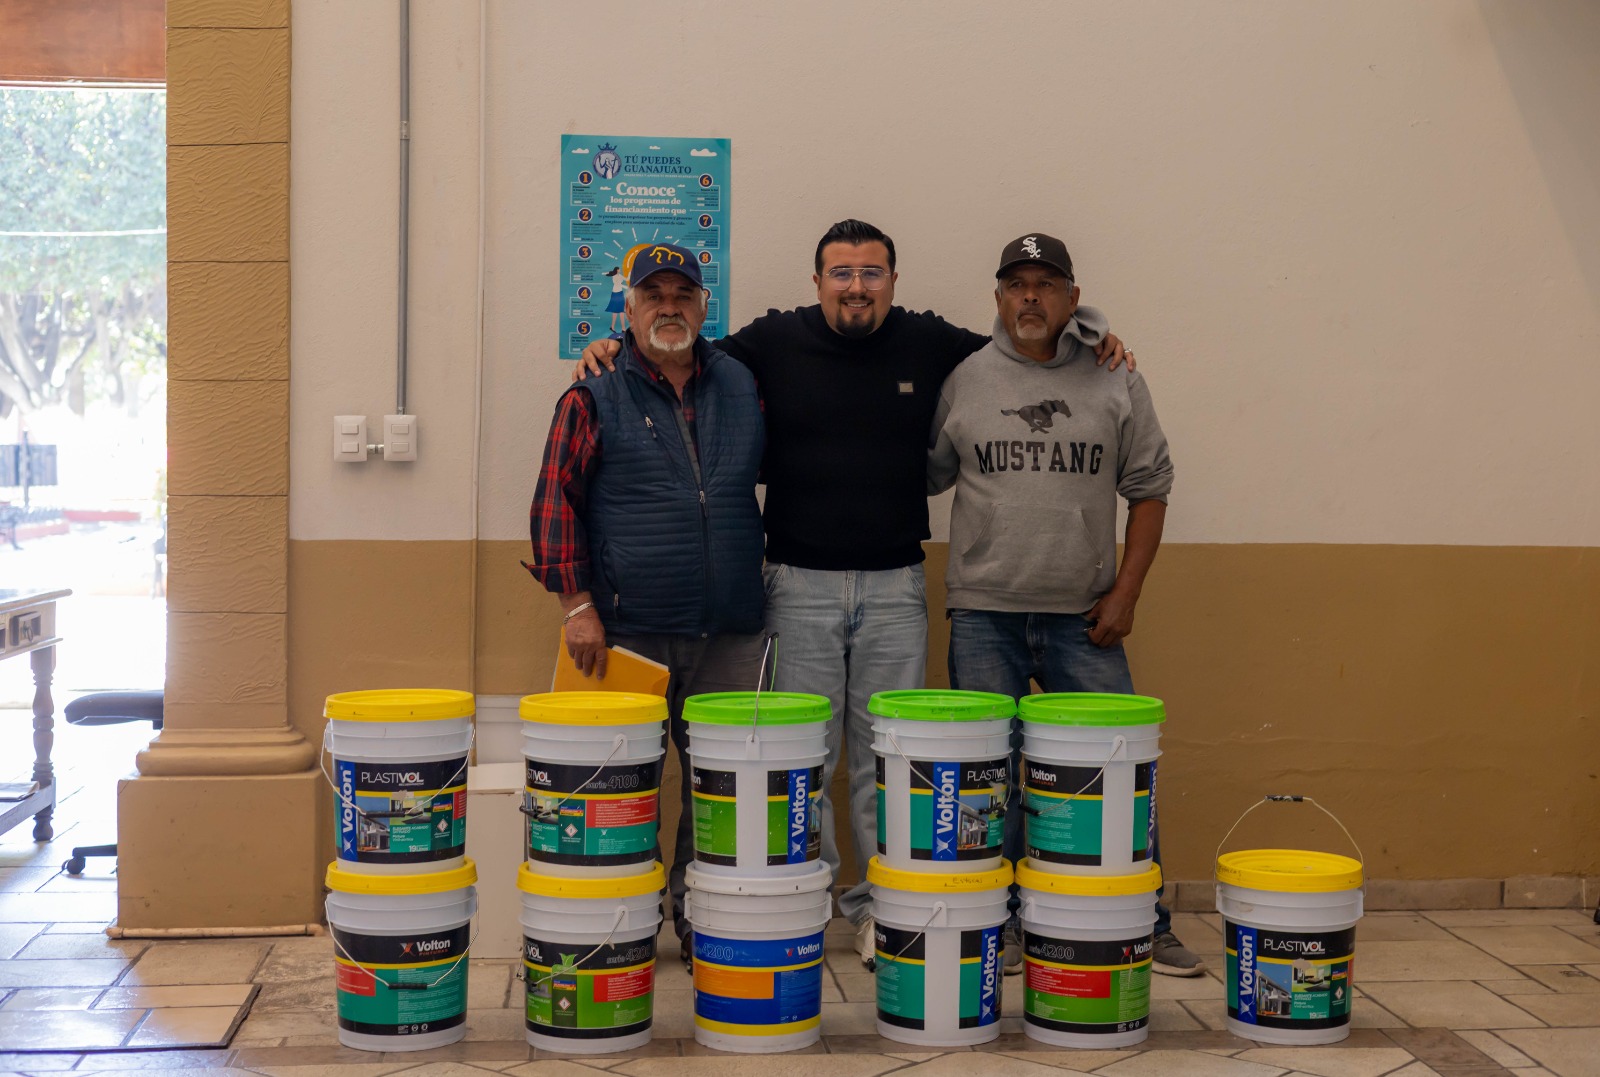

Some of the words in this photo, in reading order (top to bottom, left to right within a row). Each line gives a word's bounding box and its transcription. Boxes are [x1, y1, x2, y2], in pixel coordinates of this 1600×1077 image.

[625, 154, 638, 164] TÚ
[641, 156, 681, 164] PUEDES
[624, 165, 692, 174] GUANAJUATO
[583, 174, 588, 182] 1
[702, 176, 710, 186] 6
[616, 182, 676, 197] Conoce
[624, 198, 670, 206] programas
[582, 210, 589, 220] 2
[604, 205, 670, 214] financiamiento
[703, 217, 709, 226] 7
[582, 248, 588, 257] 3
[1021, 236, 1041, 258] Sox
[702, 253, 708, 262] 8
[581, 288, 588, 298] 4
[582, 324, 588, 333] 5
[974, 441, 1104, 476] MUSTANG
[361, 772, 424, 783] PLASTIVOL
[528, 768, 551, 783] STIVOL
[607, 774, 639, 789] 4100
[1031, 768, 1056, 782] Volton
[342, 770, 353, 833] Volton
[792, 775, 806, 837] Volton
[936, 770, 955, 834] Volton
[1148, 768, 1157, 832] Volton
[416, 939, 451, 952] Volton
[526, 945, 542, 959] VOL
[702, 943, 733, 961] 4200
[798, 943, 820, 956] Volton
[1041, 944, 1074, 960] 4200
[1264, 938, 1325, 952] PLASTIVOL
[983, 935, 996, 999] Volton
[1240, 934, 1253, 996] Volton
